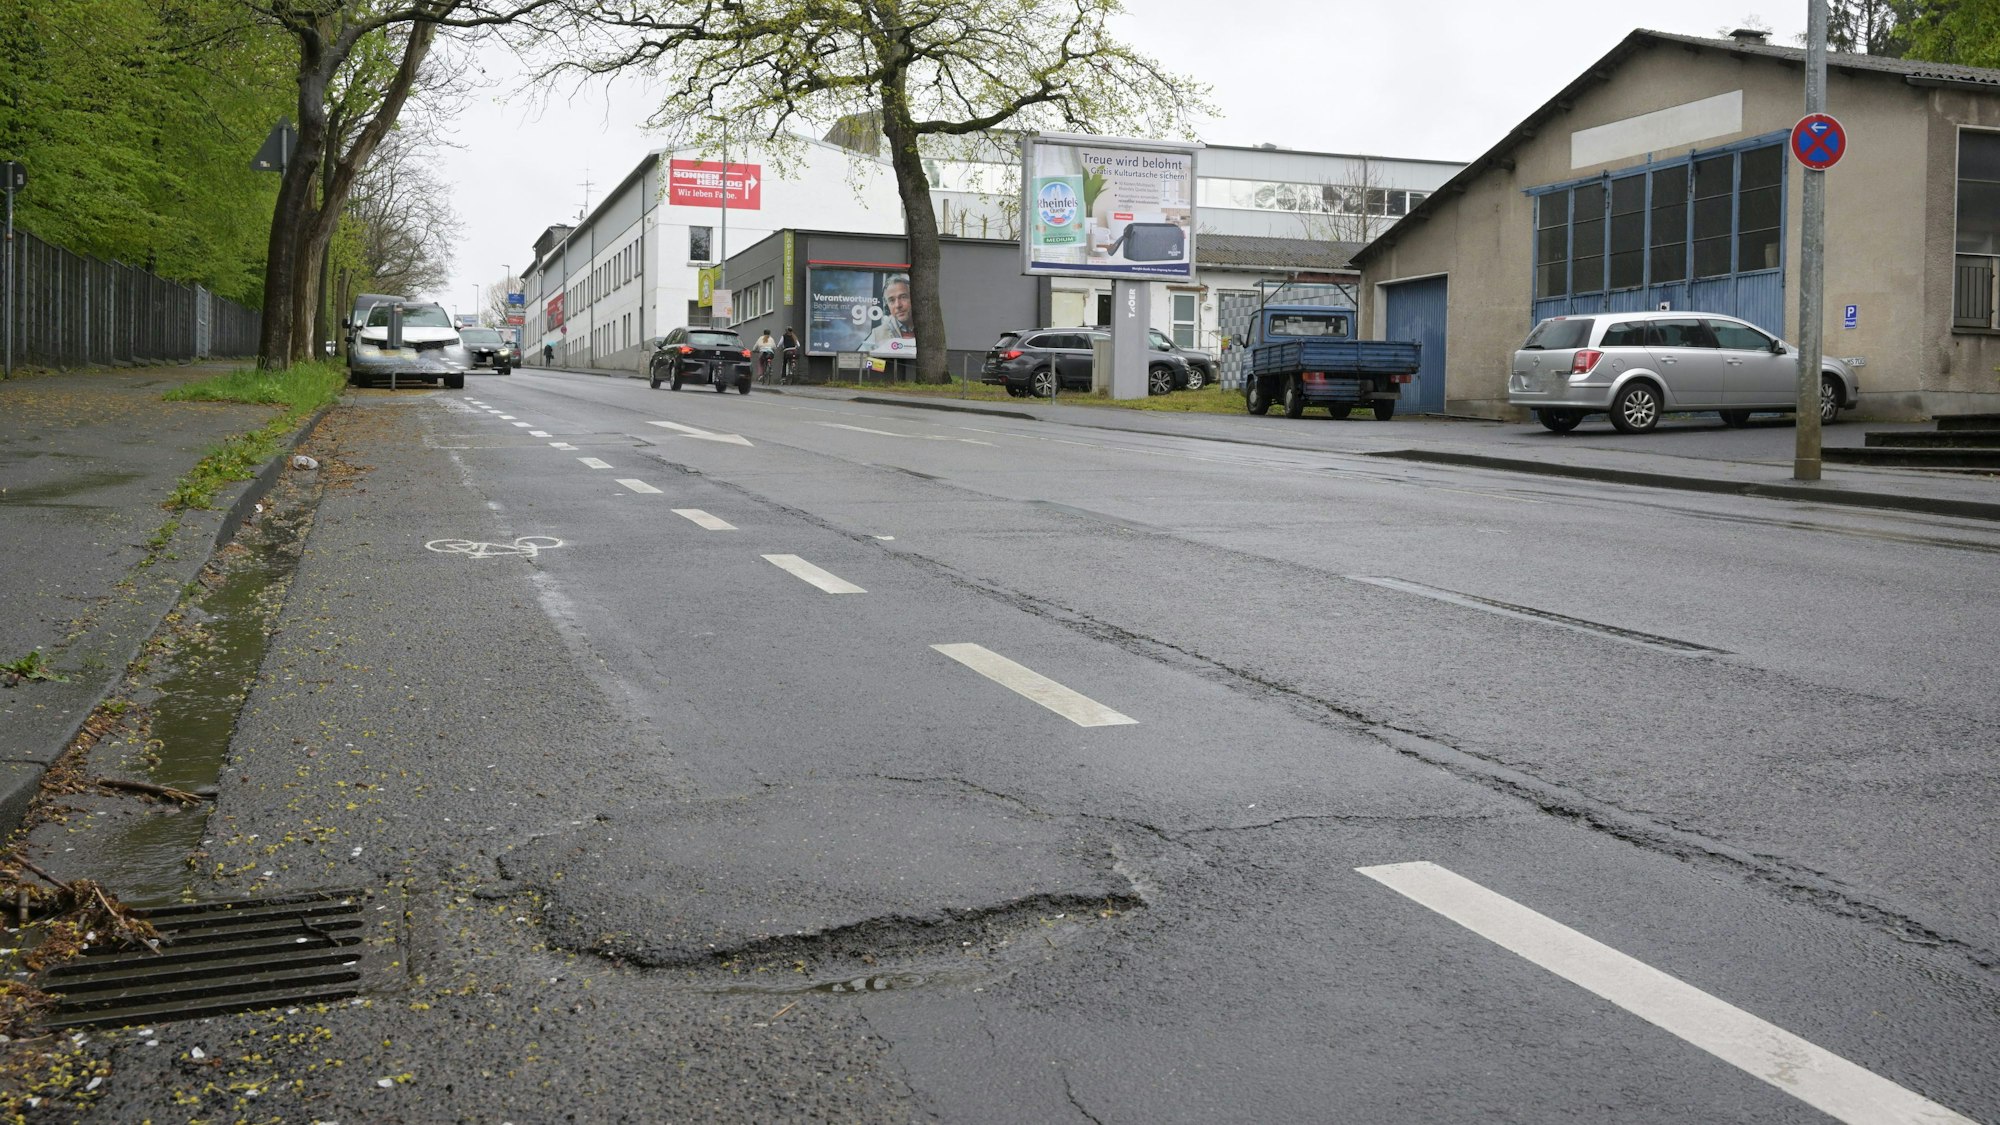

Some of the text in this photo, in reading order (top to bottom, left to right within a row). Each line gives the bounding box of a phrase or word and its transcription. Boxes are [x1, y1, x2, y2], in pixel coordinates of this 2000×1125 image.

[1083, 153, 1182, 170] Treue wird belohnt
[673, 171, 719, 180] SONNEN
[1090, 166, 1188, 180] Gratis Kulturtasche sichern!
[678, 188, 737, 199] Wir leben Fabe.
[1037, 197, 1079, 208] Rheinfels
[813, 293, 880, 305] Verantwortung.
[813, 302, 839, 311] Beginnt
[1847, 306, 1855, 317] P
[851, 305, 884, 325] go
